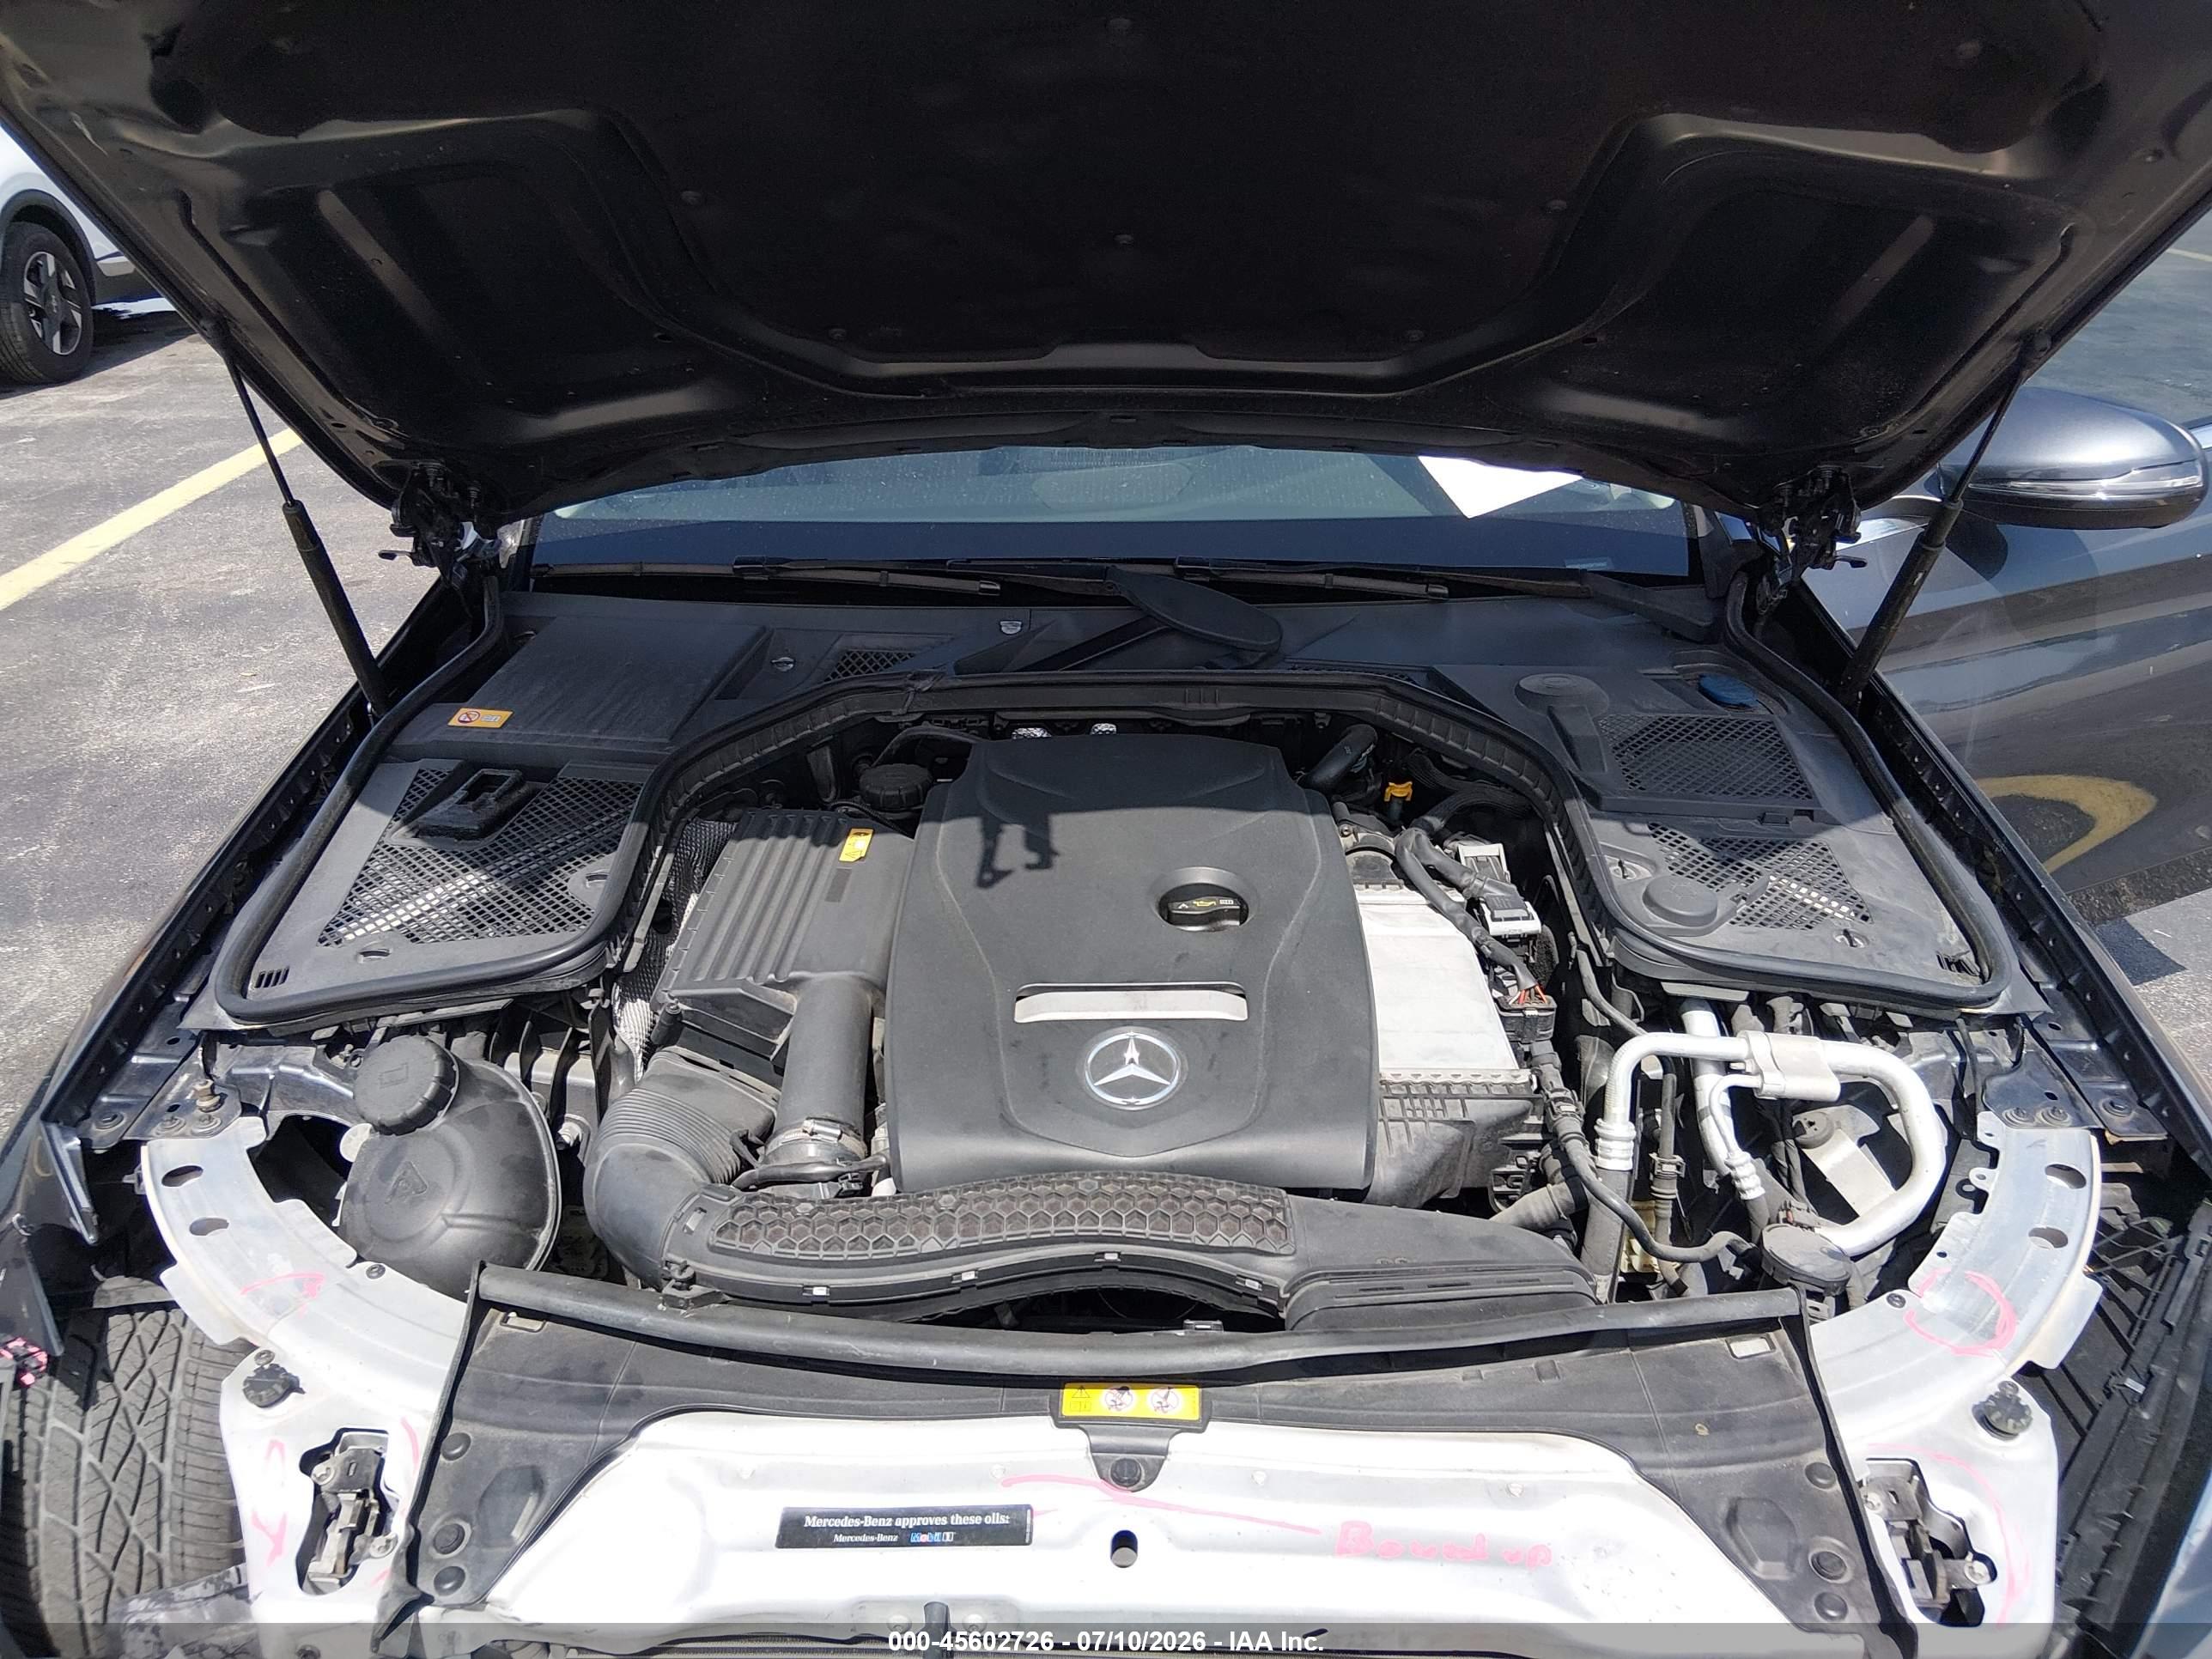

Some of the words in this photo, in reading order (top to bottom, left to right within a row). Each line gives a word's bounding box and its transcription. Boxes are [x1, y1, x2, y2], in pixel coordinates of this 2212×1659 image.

[804, 1516, 892, 1528] Mercedes-Benz
[895, 1515, 948, 1528] approves
[951, 1513, 982, 1525] these
[984, 1513, 1010, 1525] oils:
[833, 1533, 898, 1543] Mercedes-Benz
